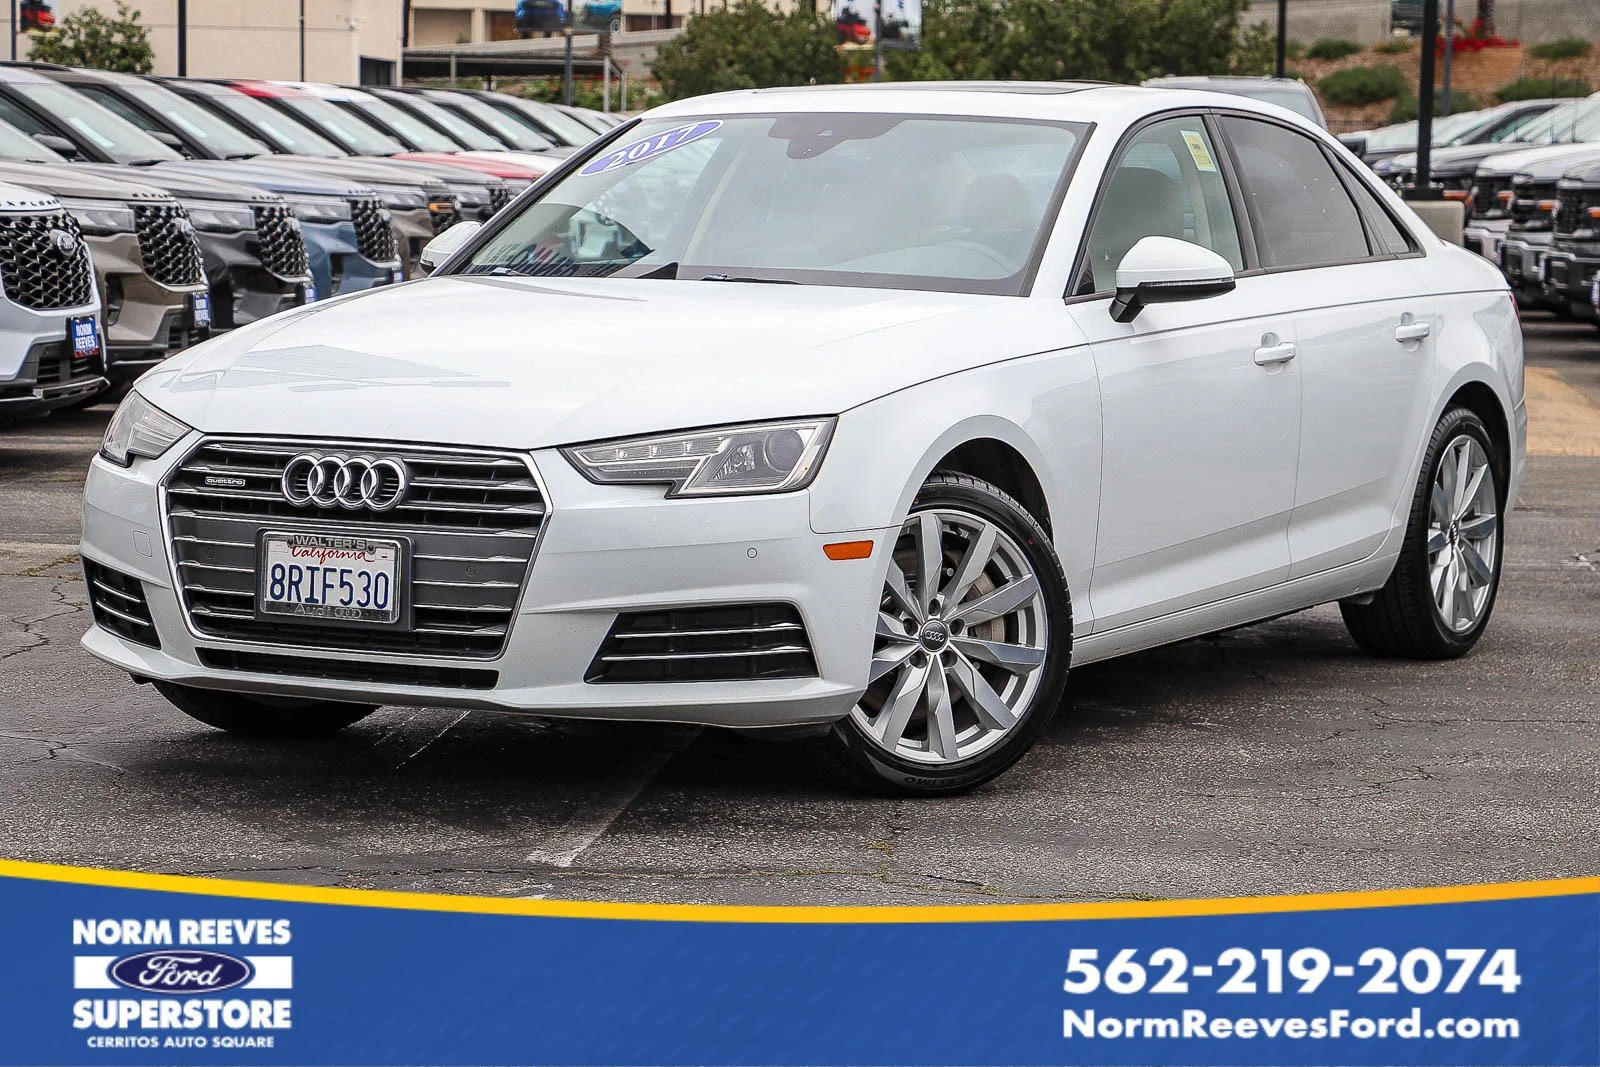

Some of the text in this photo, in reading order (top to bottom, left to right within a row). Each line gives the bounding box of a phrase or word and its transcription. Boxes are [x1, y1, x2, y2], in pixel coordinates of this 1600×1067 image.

[602, 123, 700, 171] 2017
[76, 323, 92, 337] NORM
[75, 335, 96, 350] REEVES
[296, 535, 366, 549] WALTER'S
[291, 546, 375, 565] California
[269, 563, 390, 610] 8RIF530
[294, 604, 332, 617] Audi
